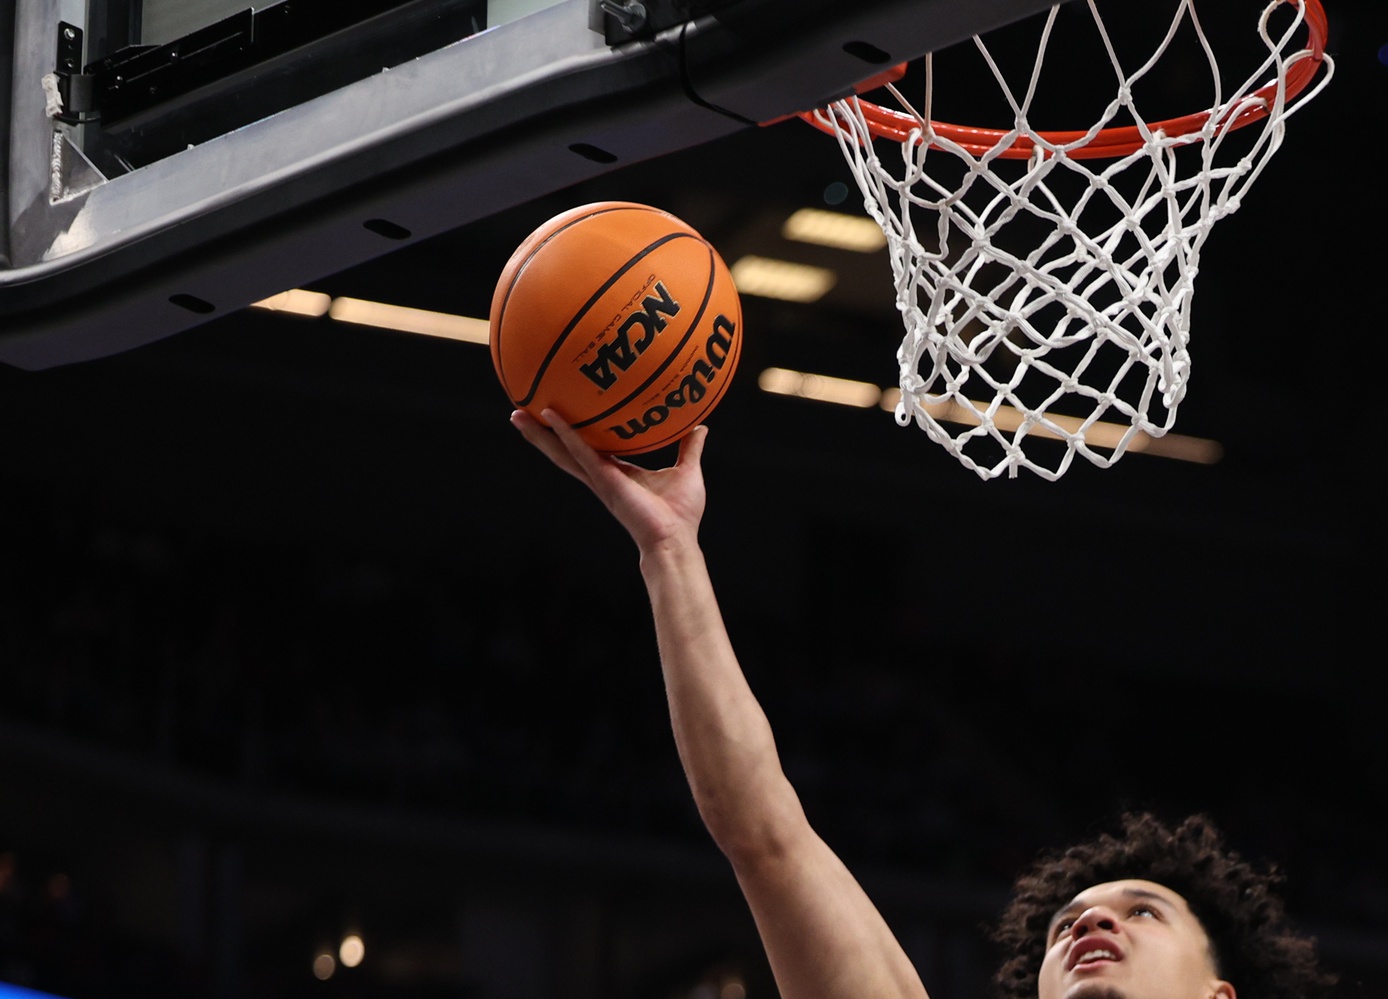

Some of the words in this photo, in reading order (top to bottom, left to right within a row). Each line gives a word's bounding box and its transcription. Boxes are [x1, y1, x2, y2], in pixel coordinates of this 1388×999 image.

[621, 273, 656, 314] OFFICIAL
[579, 280, 681, 391] NCAA
[595, 314, 623, 342] GAME
[571, 341, 596, 364] BALL
[610, 314, 735, 439] Wilson
